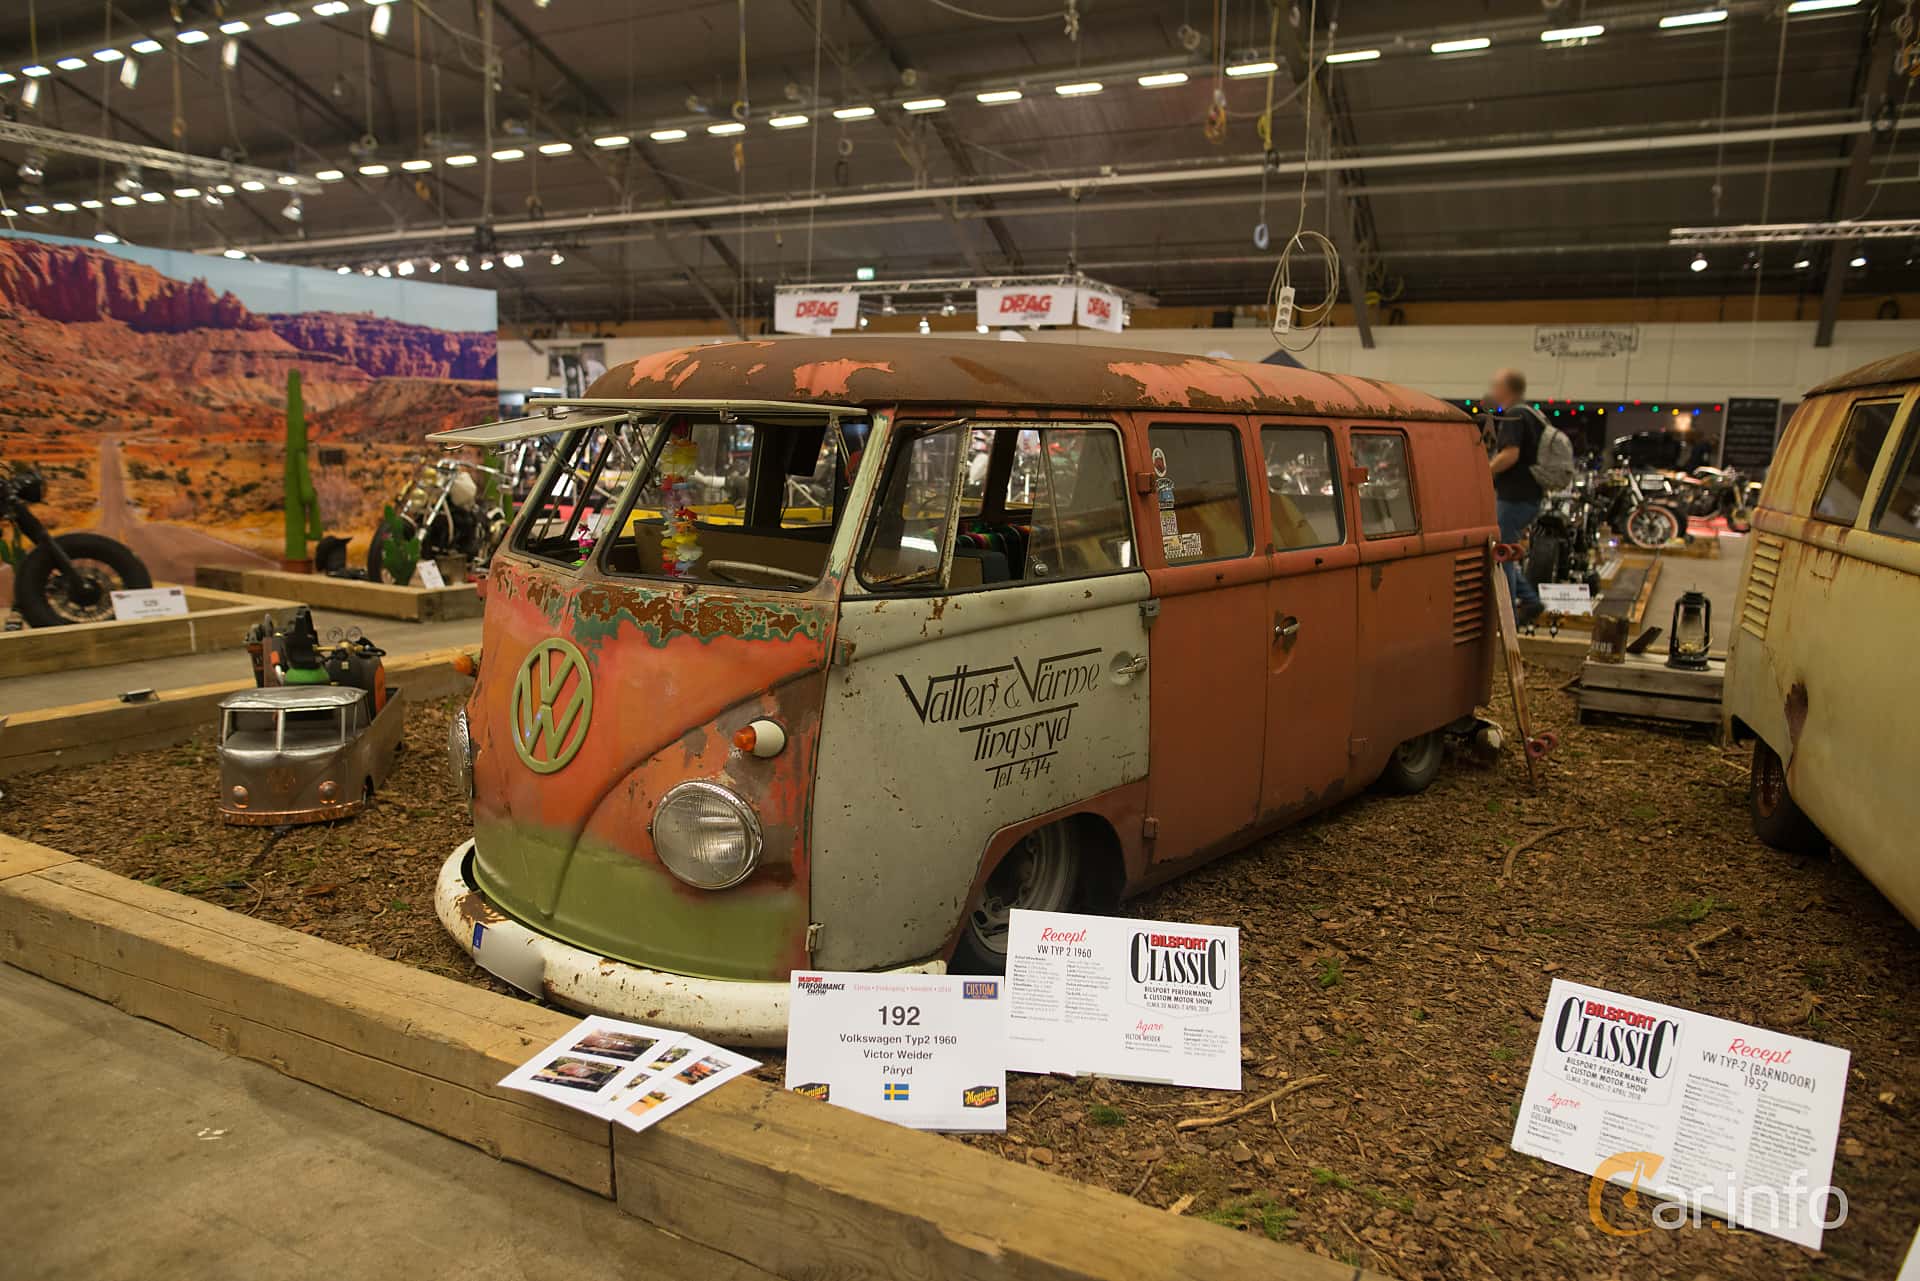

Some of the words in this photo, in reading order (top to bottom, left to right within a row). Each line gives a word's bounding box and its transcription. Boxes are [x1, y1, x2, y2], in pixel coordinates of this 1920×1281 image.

[796, 300, 839, 318] DRAG
[1000, 293, 1053, 313] DRAG
[1087, 296, 1111, 319] DRAG
[1013, 648, 1102, 704] Värme
[958, 703, 1079, 761] Tingsryd
[1020, 756, 1050, 780] 474
[1041, 927, 1087, 945] Recept
[1150, 933, 1208, 951] BILSPORT
[1037, 944, 1049, 955] VW
[1051, 945, 1065, 956] TYP
[1066, 947, 1071, 957] 2
[1074, 947, 1092, 959] 1960
[1130, 932, 1227, 991] CLASSIC
[797, 982, 845, 991] PERFORMANCE
[966, 983, 995, 996] CUSTOM
[1144, 986, 1170, 994] BILSPORT
[1171, 988, 1212, 998] PERFORMANCE
[1173, 996, 1194, 1004] MOTOR
[878, 1005, 921, 1026] 192
[1585, 1000, 1657, 1031] BILSPORT
[839, 1033, 902, 1046] Volkswagen
[905, 1034, 930, 1046] Typ2
[934, 1035, 957, 1045] 1960
[1555, 996, 1679, 1079] CLASSIC
[863, 1049, 894, 1059] Victor
[897, 1050, 933, 1060] Weider
[1728, 1038, 1792, 1066] Recept
[1563, 1064, 1568, 1072] &
[1570, 1066, 1597, 1078] CUSTOM
[1600, 1075, 1625, 1086] MOTOR
[1626, 1082, 1648, 1093] SHOW
[1566, 1057, 1597, 1071] BILSPORT
[1598, 1065, 1649, 1085] PERFORMANCE
[1702, 1050, 1718, 1064] VW
[1720, 1055, 1747, 1072] TYP-2
[1750, 1063, 1816, 1093] (BARNDOOR)
[1744, 1075, 1769, 1092] 1952
